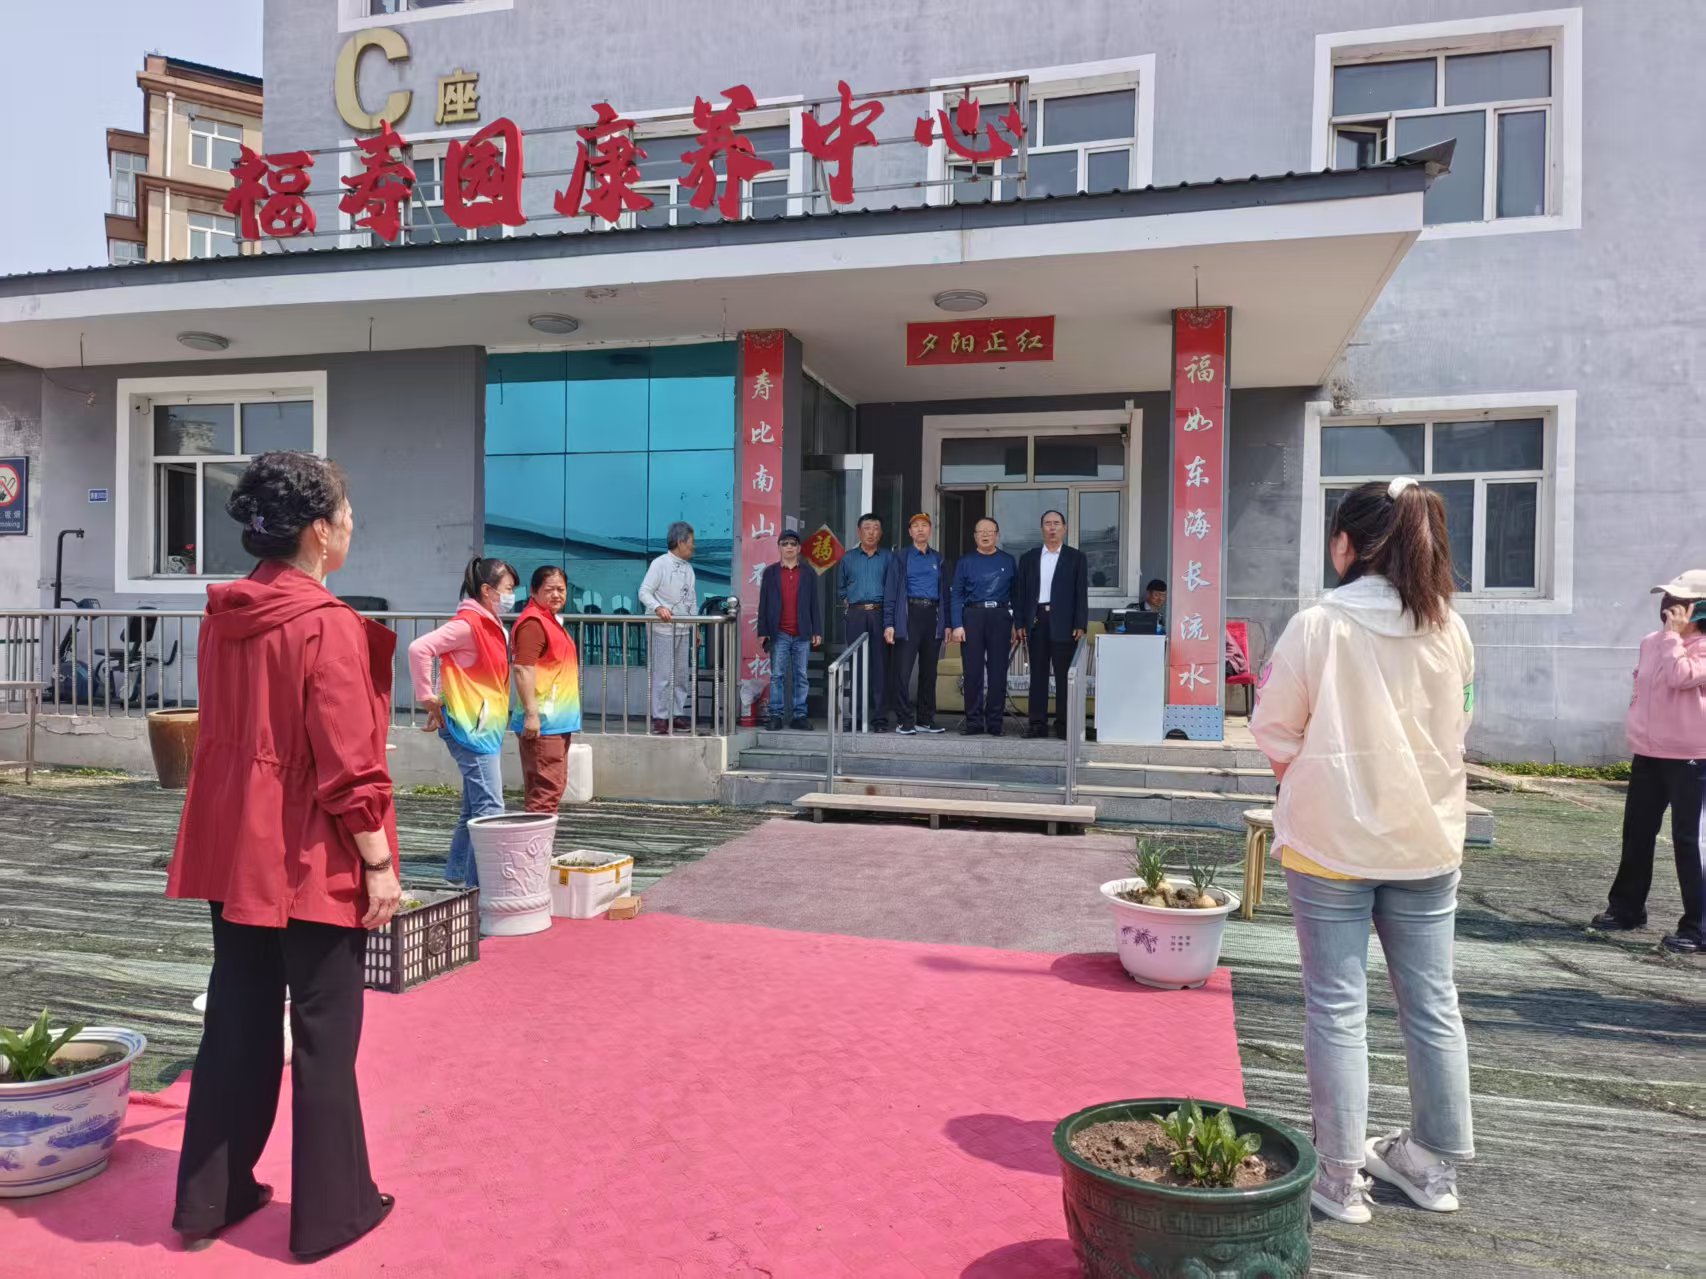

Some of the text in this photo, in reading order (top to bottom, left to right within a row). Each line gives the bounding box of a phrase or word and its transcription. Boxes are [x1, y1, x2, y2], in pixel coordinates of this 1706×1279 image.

[335, 28, 480, 131] C座
[916, 329, 1044, 359] 夕阳正红
[812, 535, 833, 561] 福
[1178, 355, 1215, 691] 福如东海长流水
